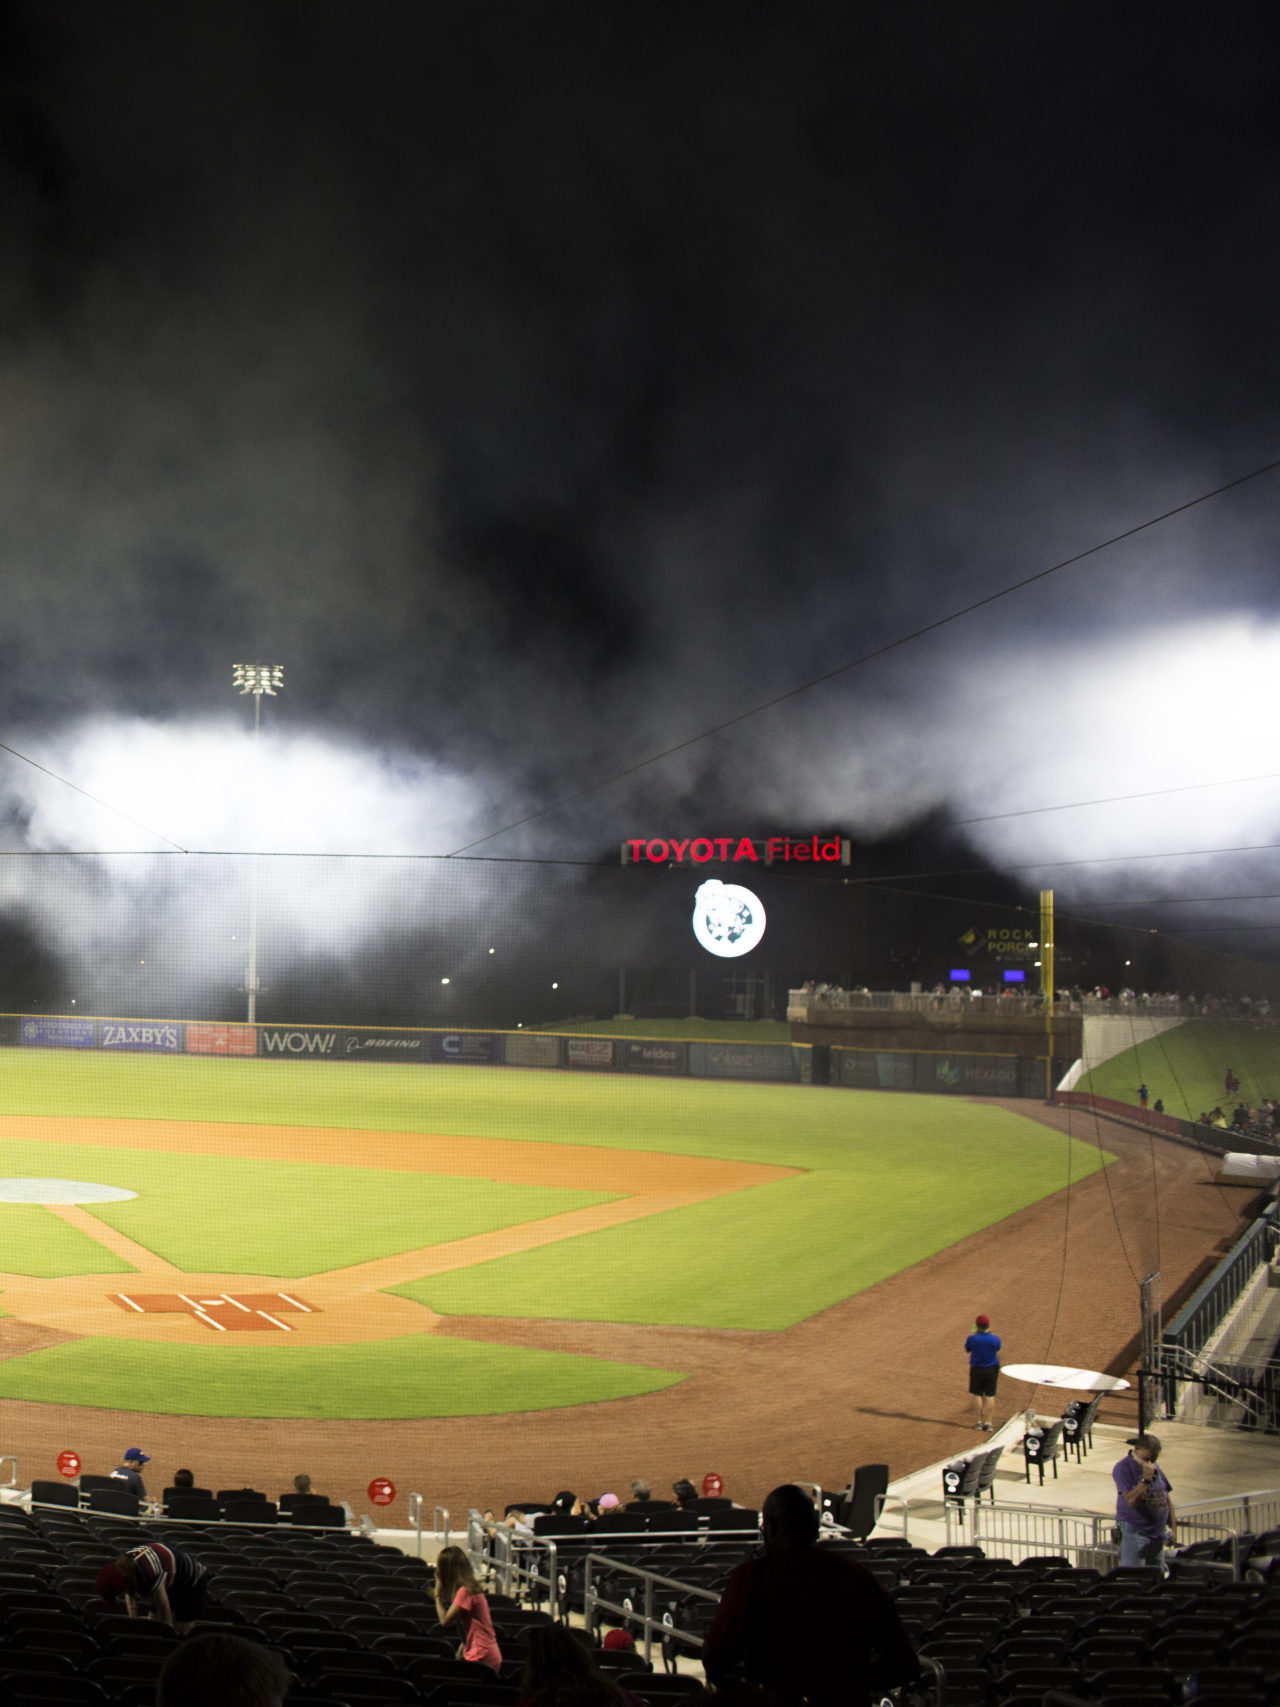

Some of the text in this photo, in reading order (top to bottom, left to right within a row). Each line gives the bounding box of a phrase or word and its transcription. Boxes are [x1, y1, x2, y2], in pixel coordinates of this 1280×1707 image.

[627, 835, 840, 863] TOYOTA Field
[987, 928, 1034, 940] ROCK
[103, 1025, 177, 1048] ZAXBY'S
[264, 1031, 336, 1053] WOW!
[364, 1038, 421, 1049] BOEING
[643, 1047, 677, 1060] leidos
[964, 1068, 1017, 1081] HEXAGO
